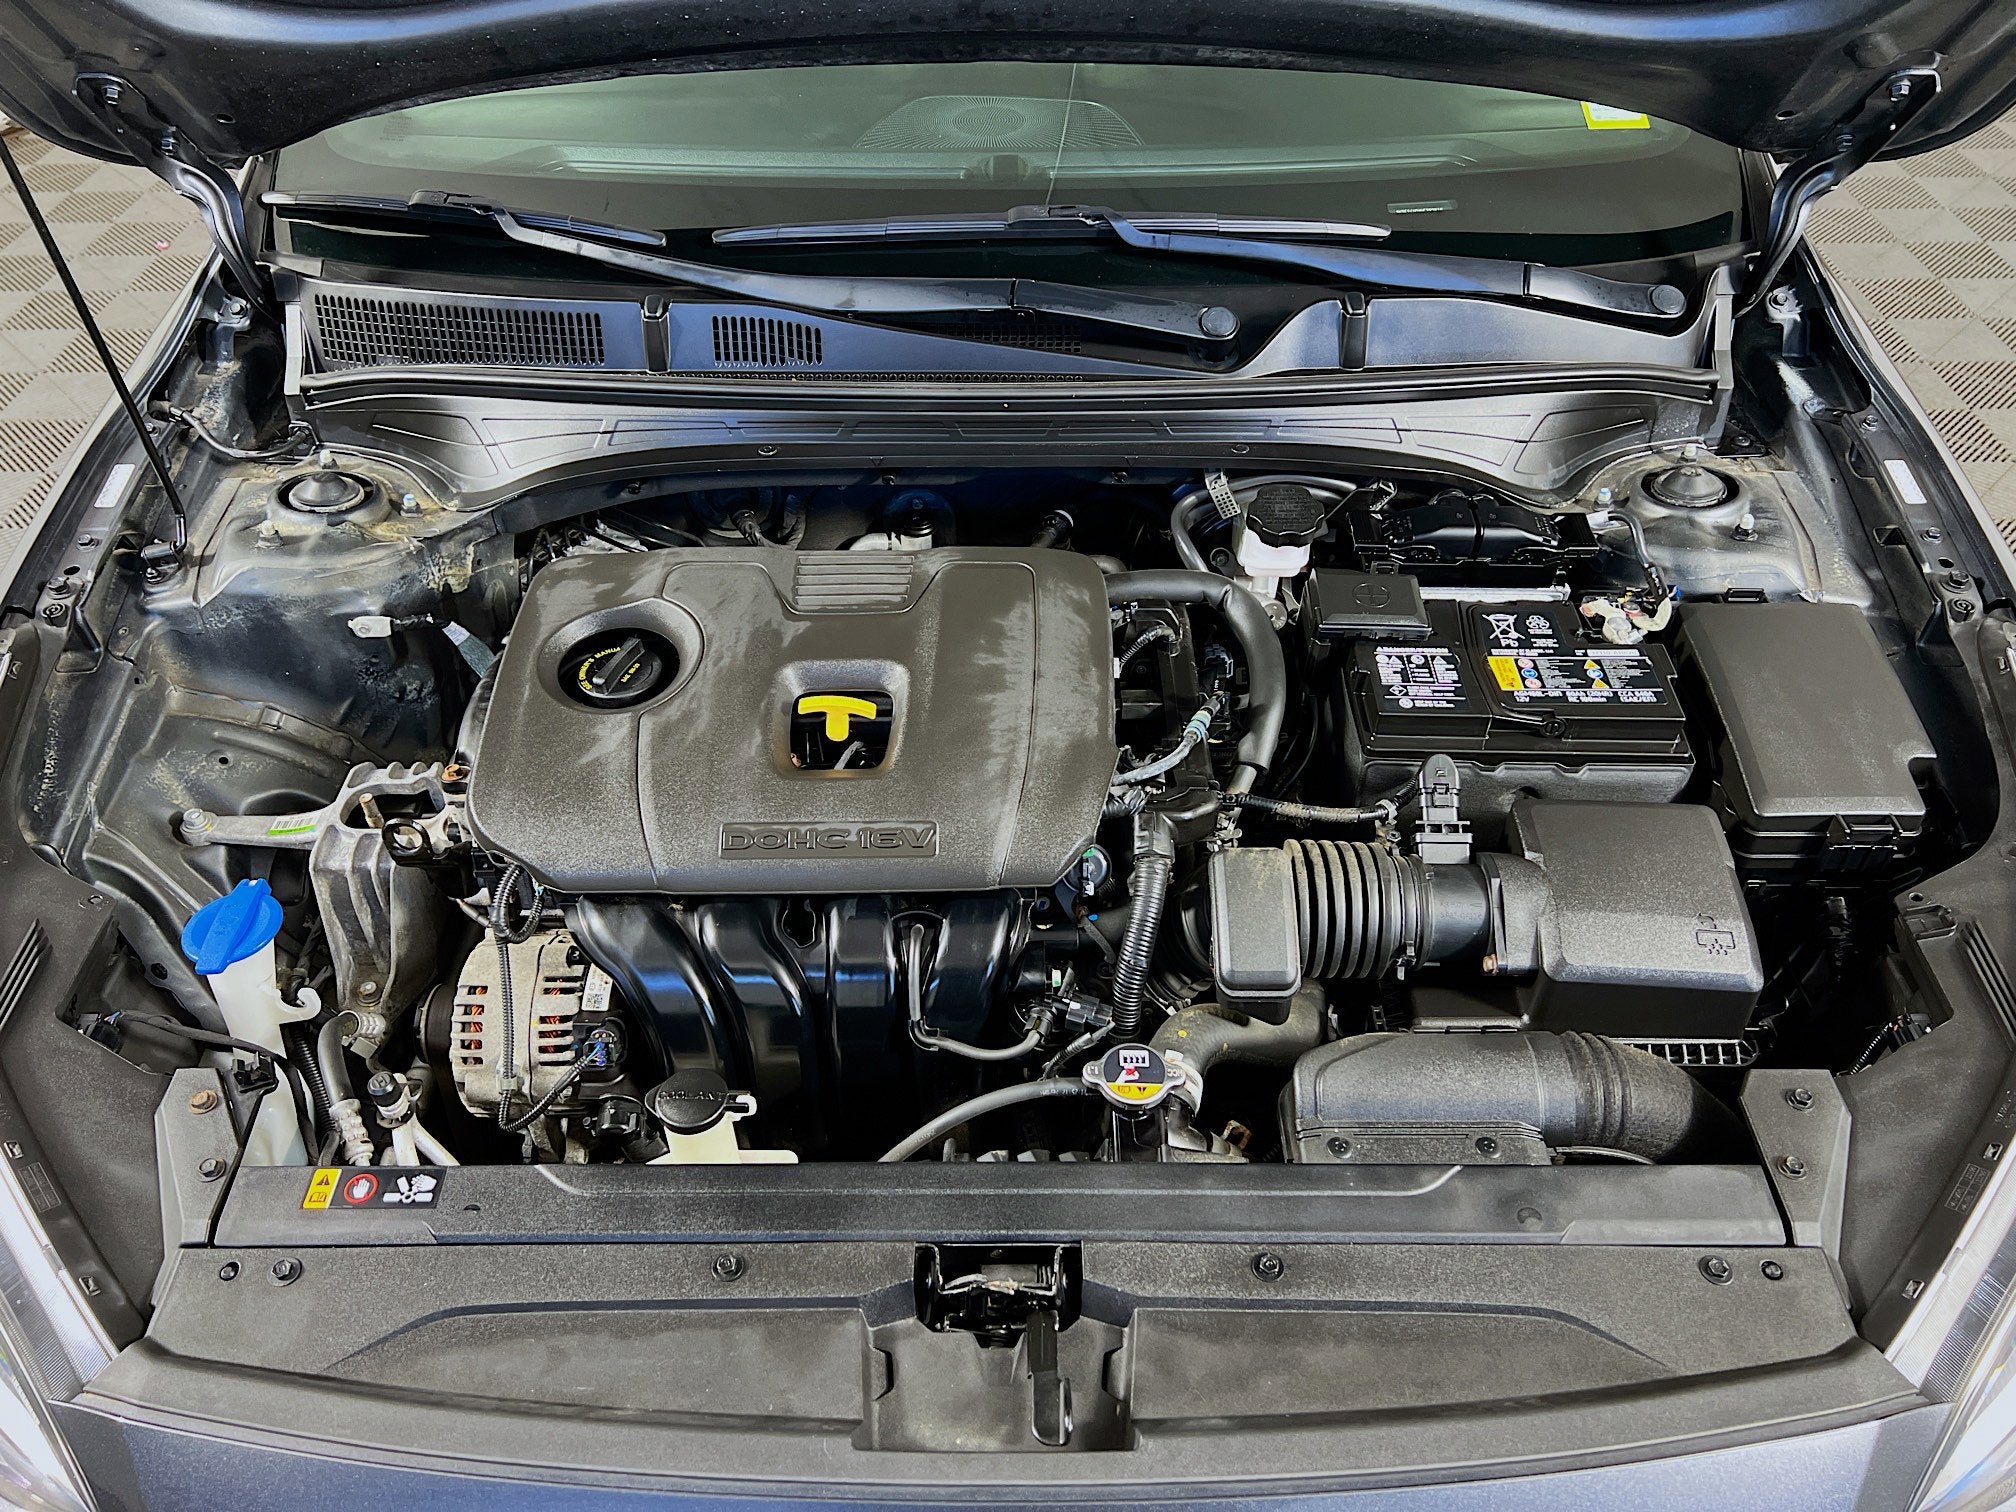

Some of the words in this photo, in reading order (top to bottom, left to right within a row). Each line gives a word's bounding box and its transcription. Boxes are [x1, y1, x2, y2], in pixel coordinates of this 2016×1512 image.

[1500, 639, 1519, 647] Pb
[594, 647, 621, 658] MANUA
[722, 829, 851, 850] DOHC
[859, 828, 937, 849] 16V
